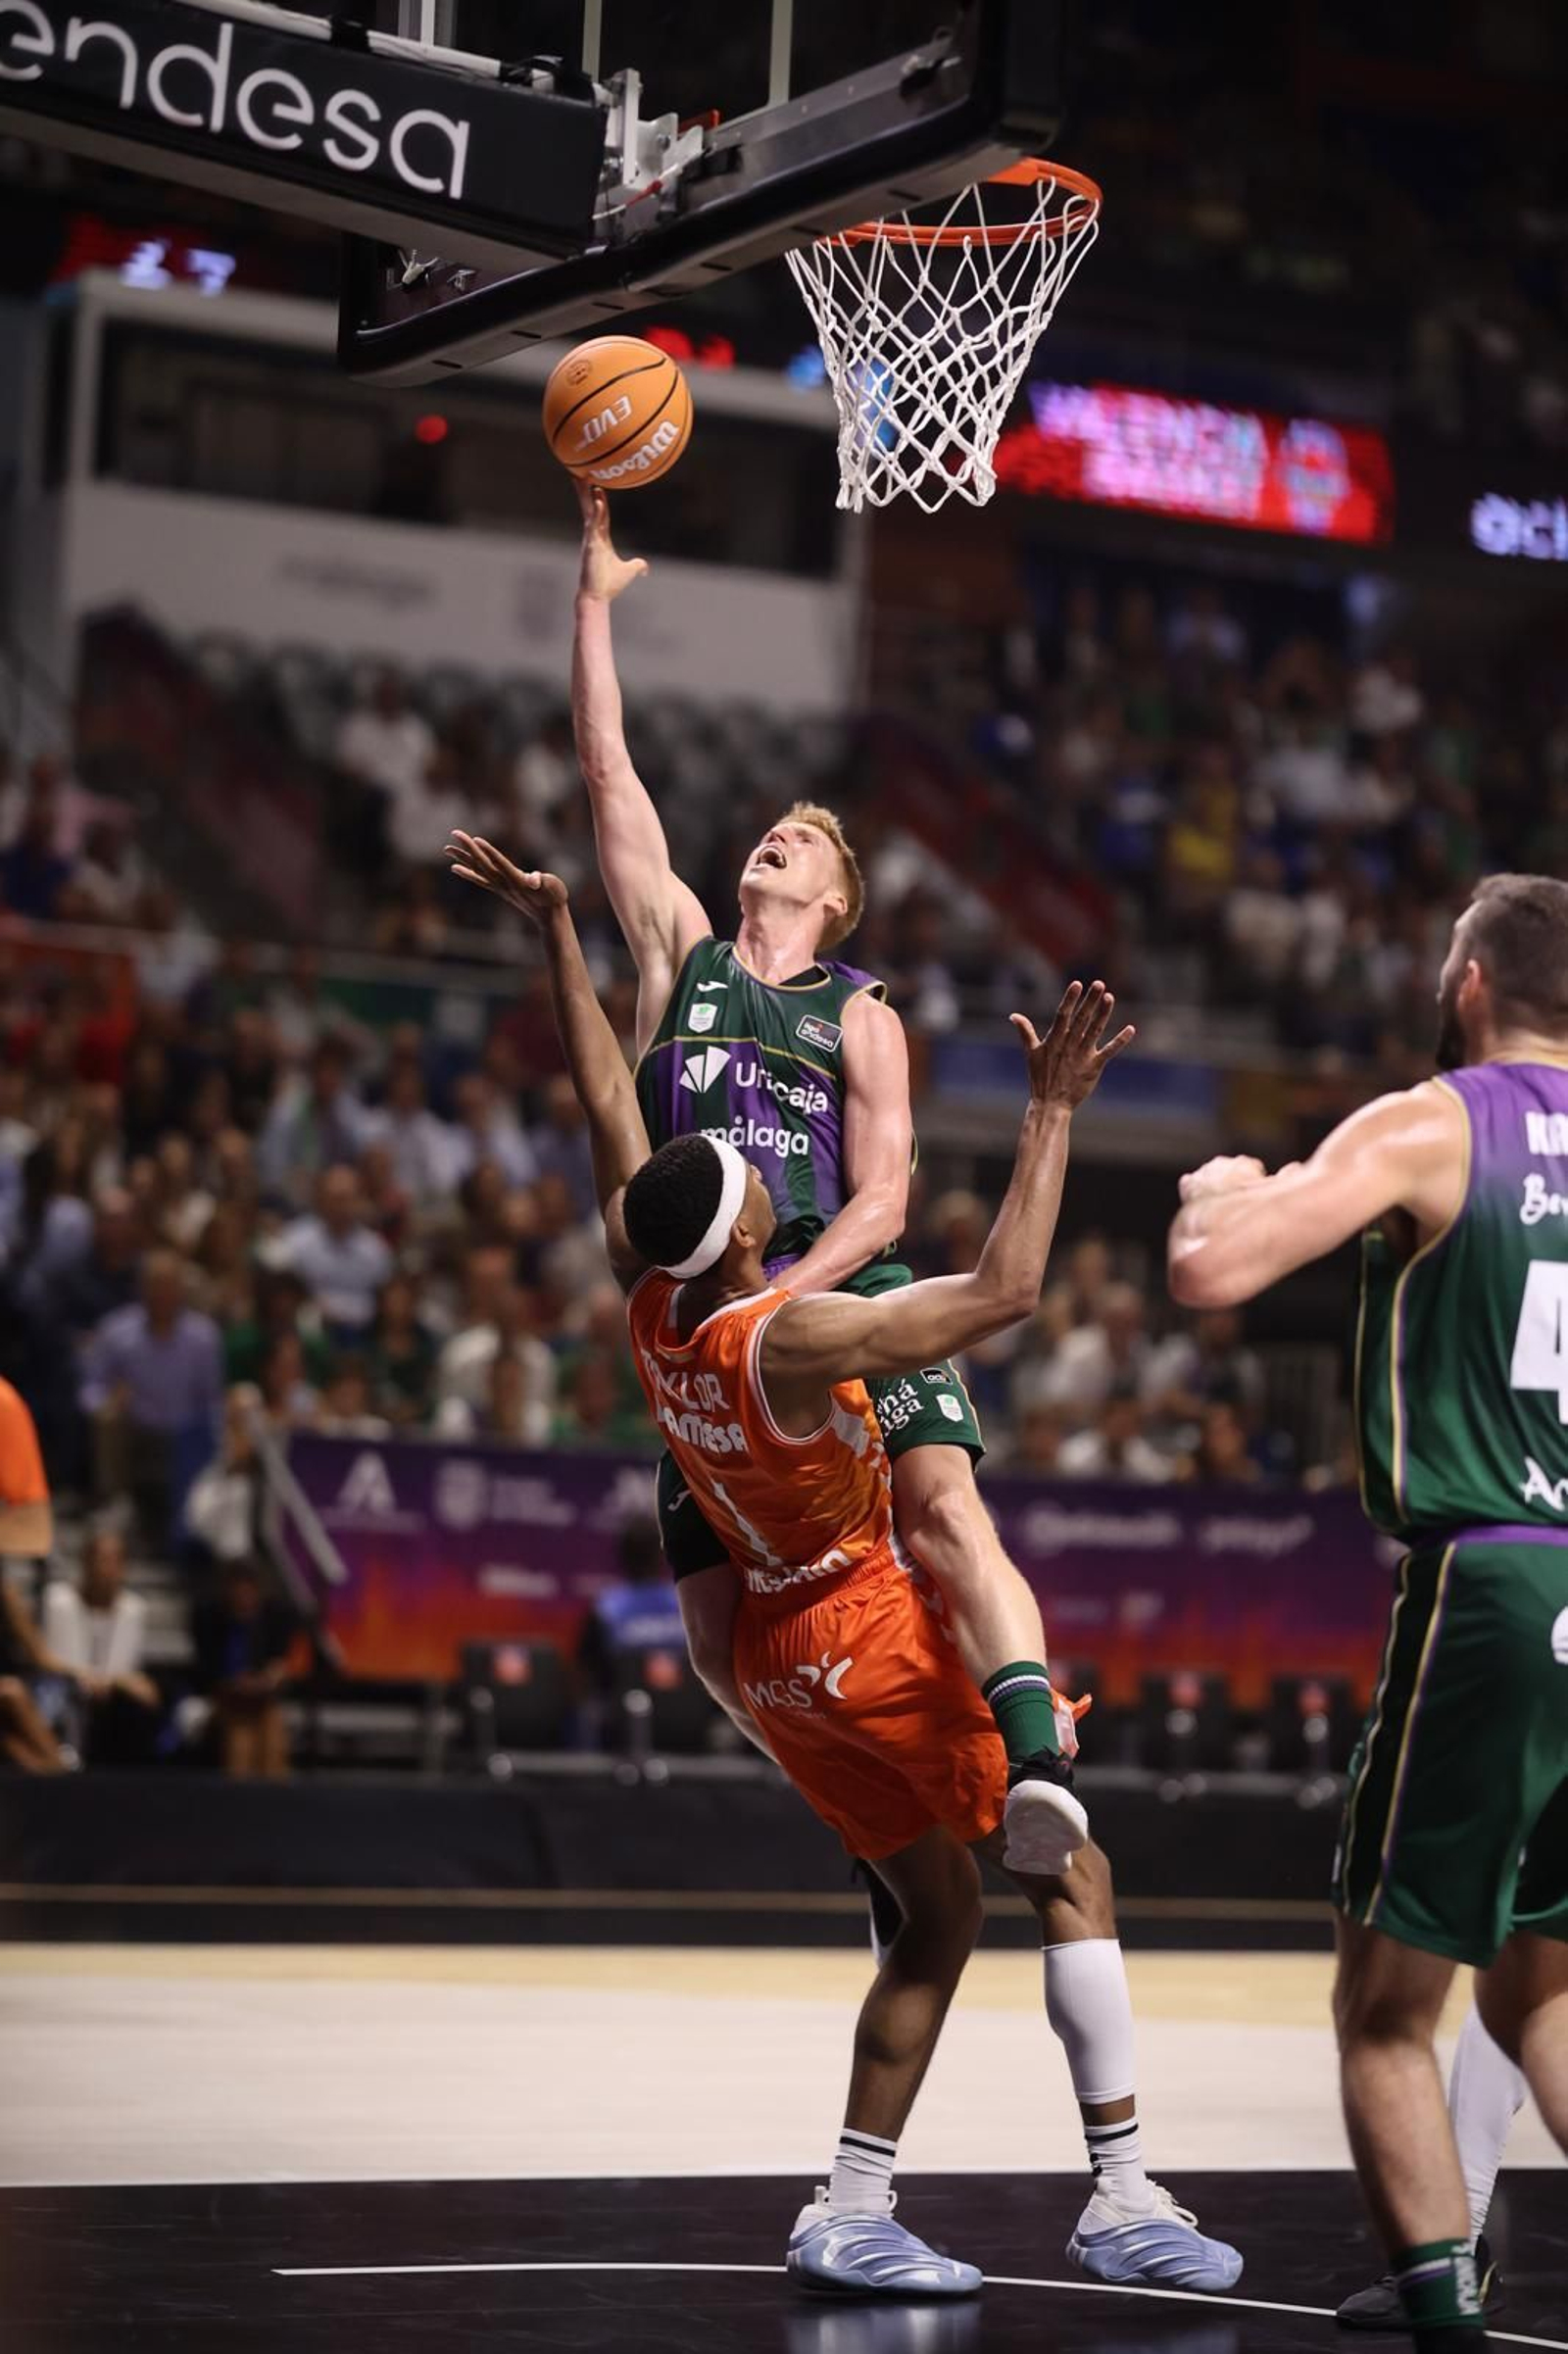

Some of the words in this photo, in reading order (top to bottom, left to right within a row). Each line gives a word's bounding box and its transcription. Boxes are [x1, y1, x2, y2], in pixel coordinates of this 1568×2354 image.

[0, 0, 470, 199] endesa
[583, 395, 632, 443] EVO
[590, 420, 679, 480] Wilson
[736, 1062, 828, 1115] Unicaja
[743, 1679, 812, 1709] MGS
